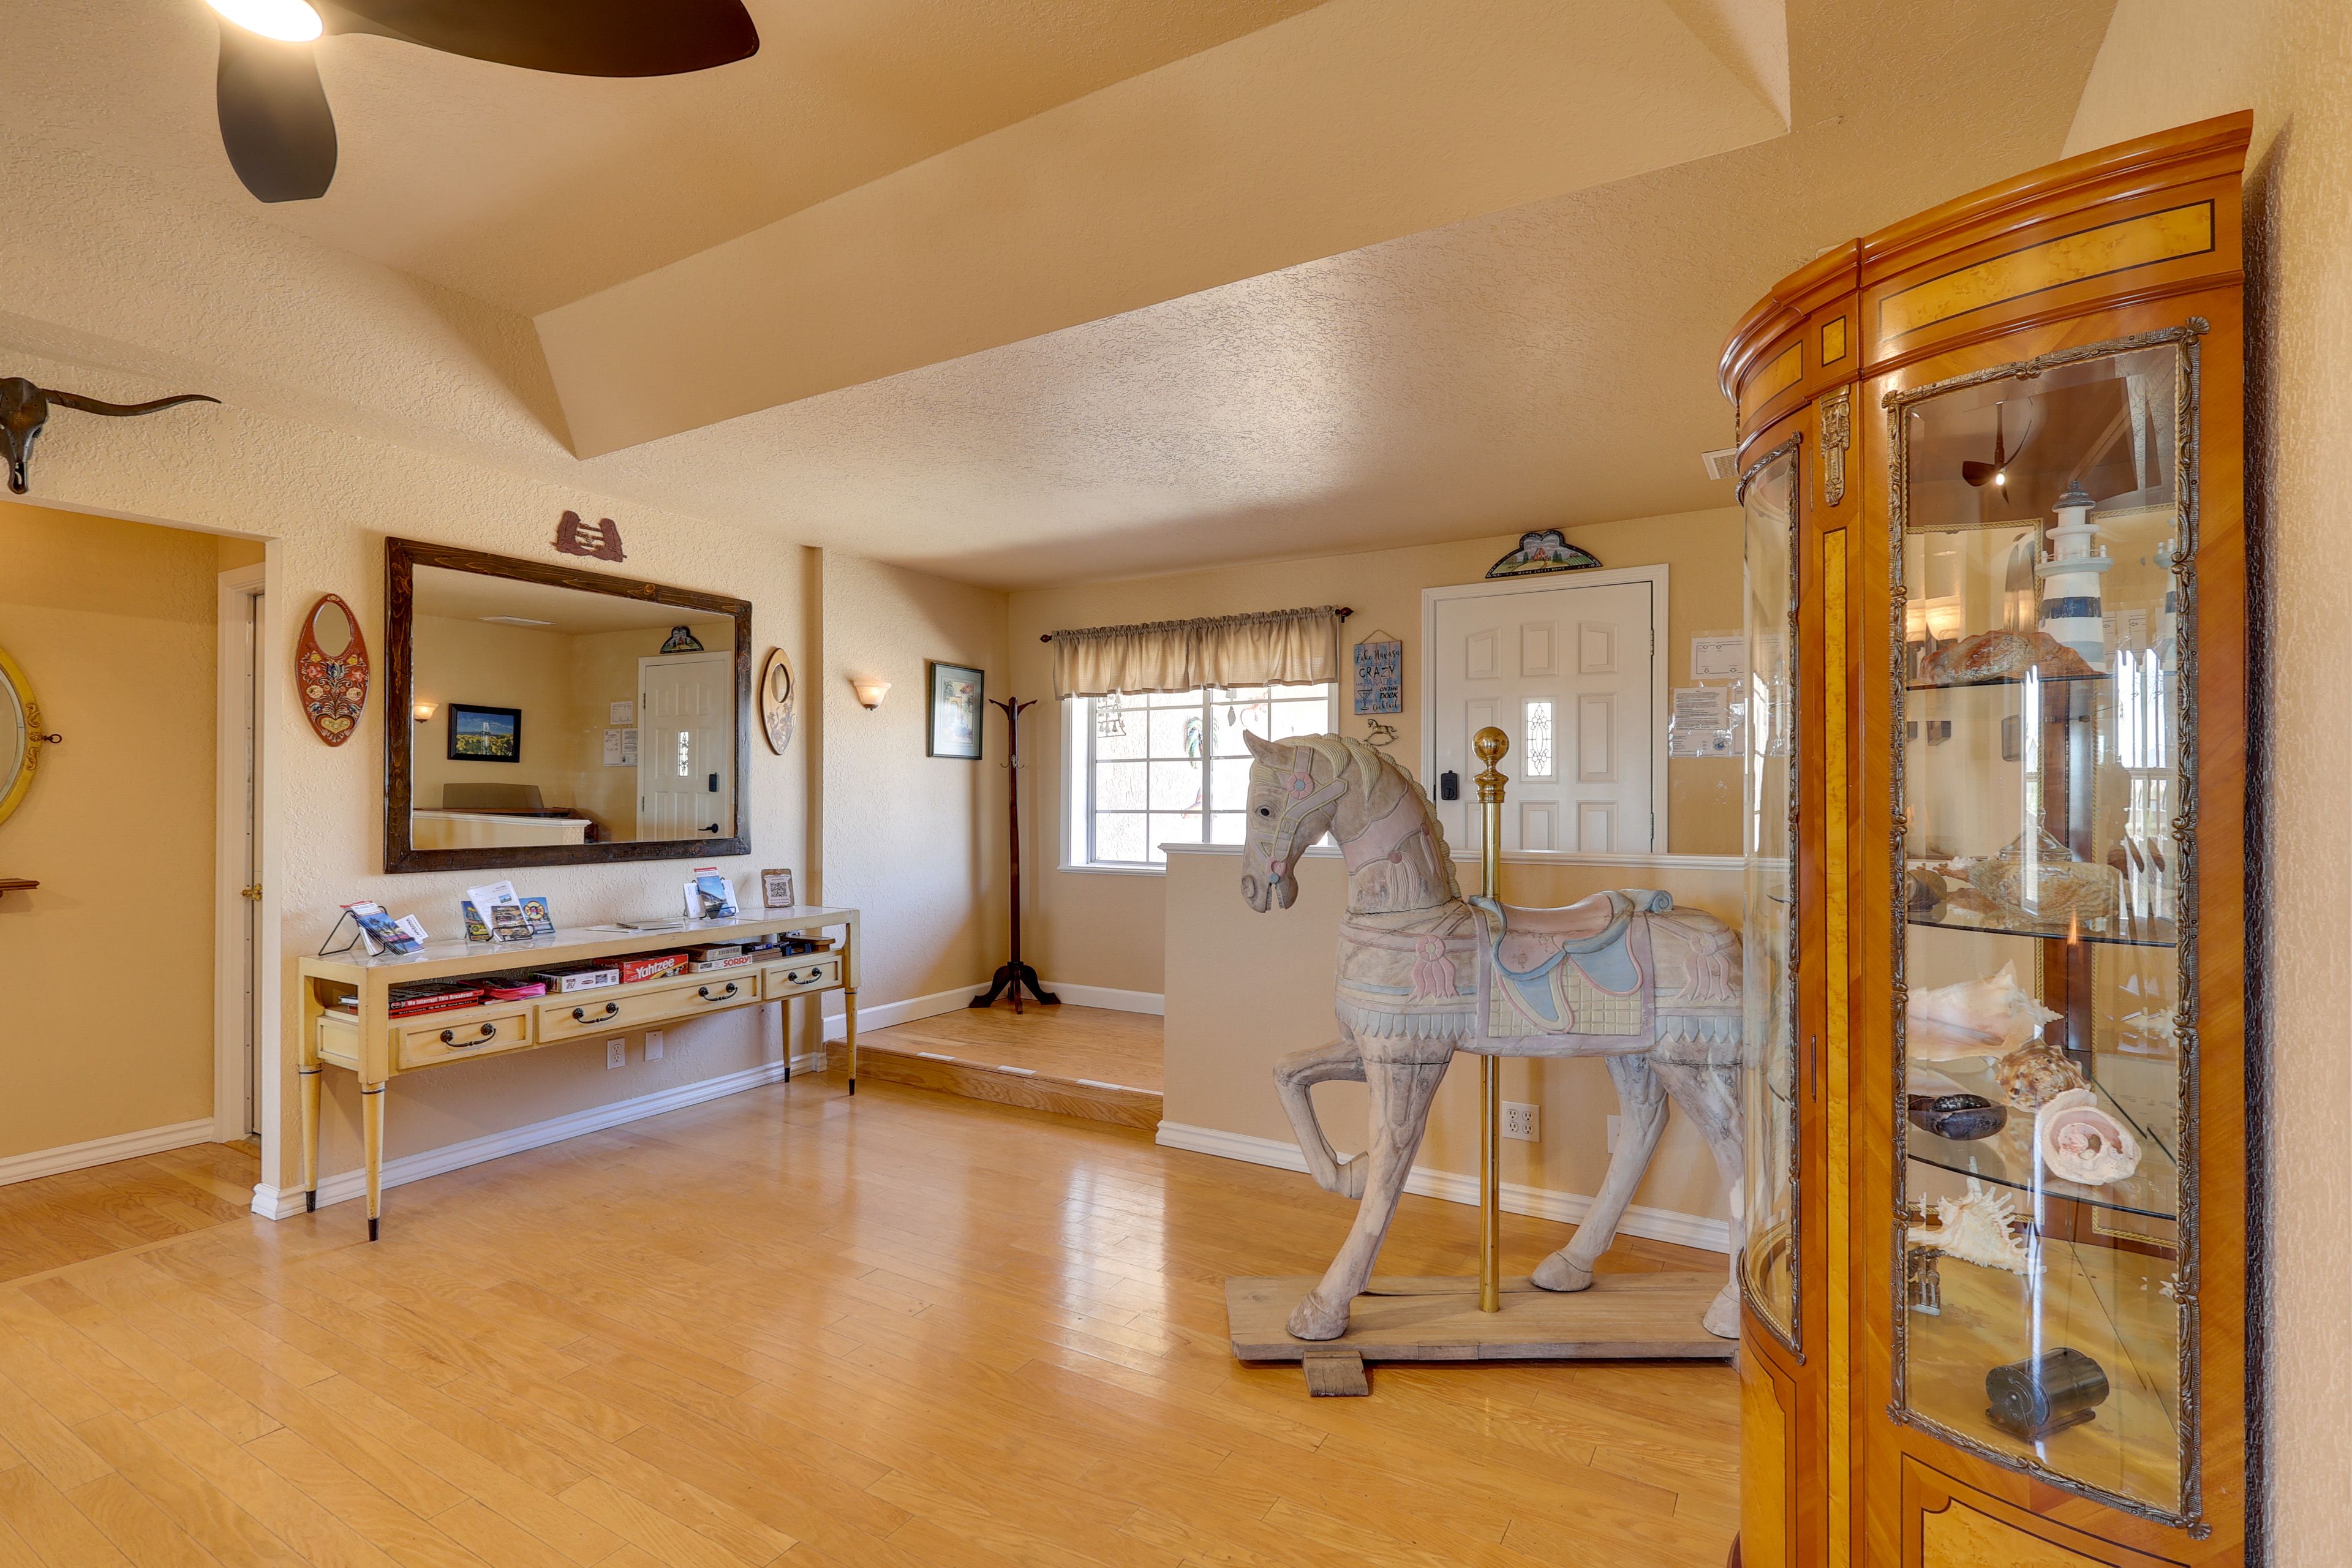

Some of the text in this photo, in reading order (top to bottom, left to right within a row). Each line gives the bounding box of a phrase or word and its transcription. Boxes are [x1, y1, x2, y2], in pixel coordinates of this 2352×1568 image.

[1355, 649, 1372, 663] Lake
[1359, 665, 1395, 678] CRAZY
[1364, 677, 1393, 687] PARADE
[1373, 698, 1398, 711] Cocktail
[635, 957, 675, 979] Yahtzee
[723, 956, 751, 967] SORRY!
